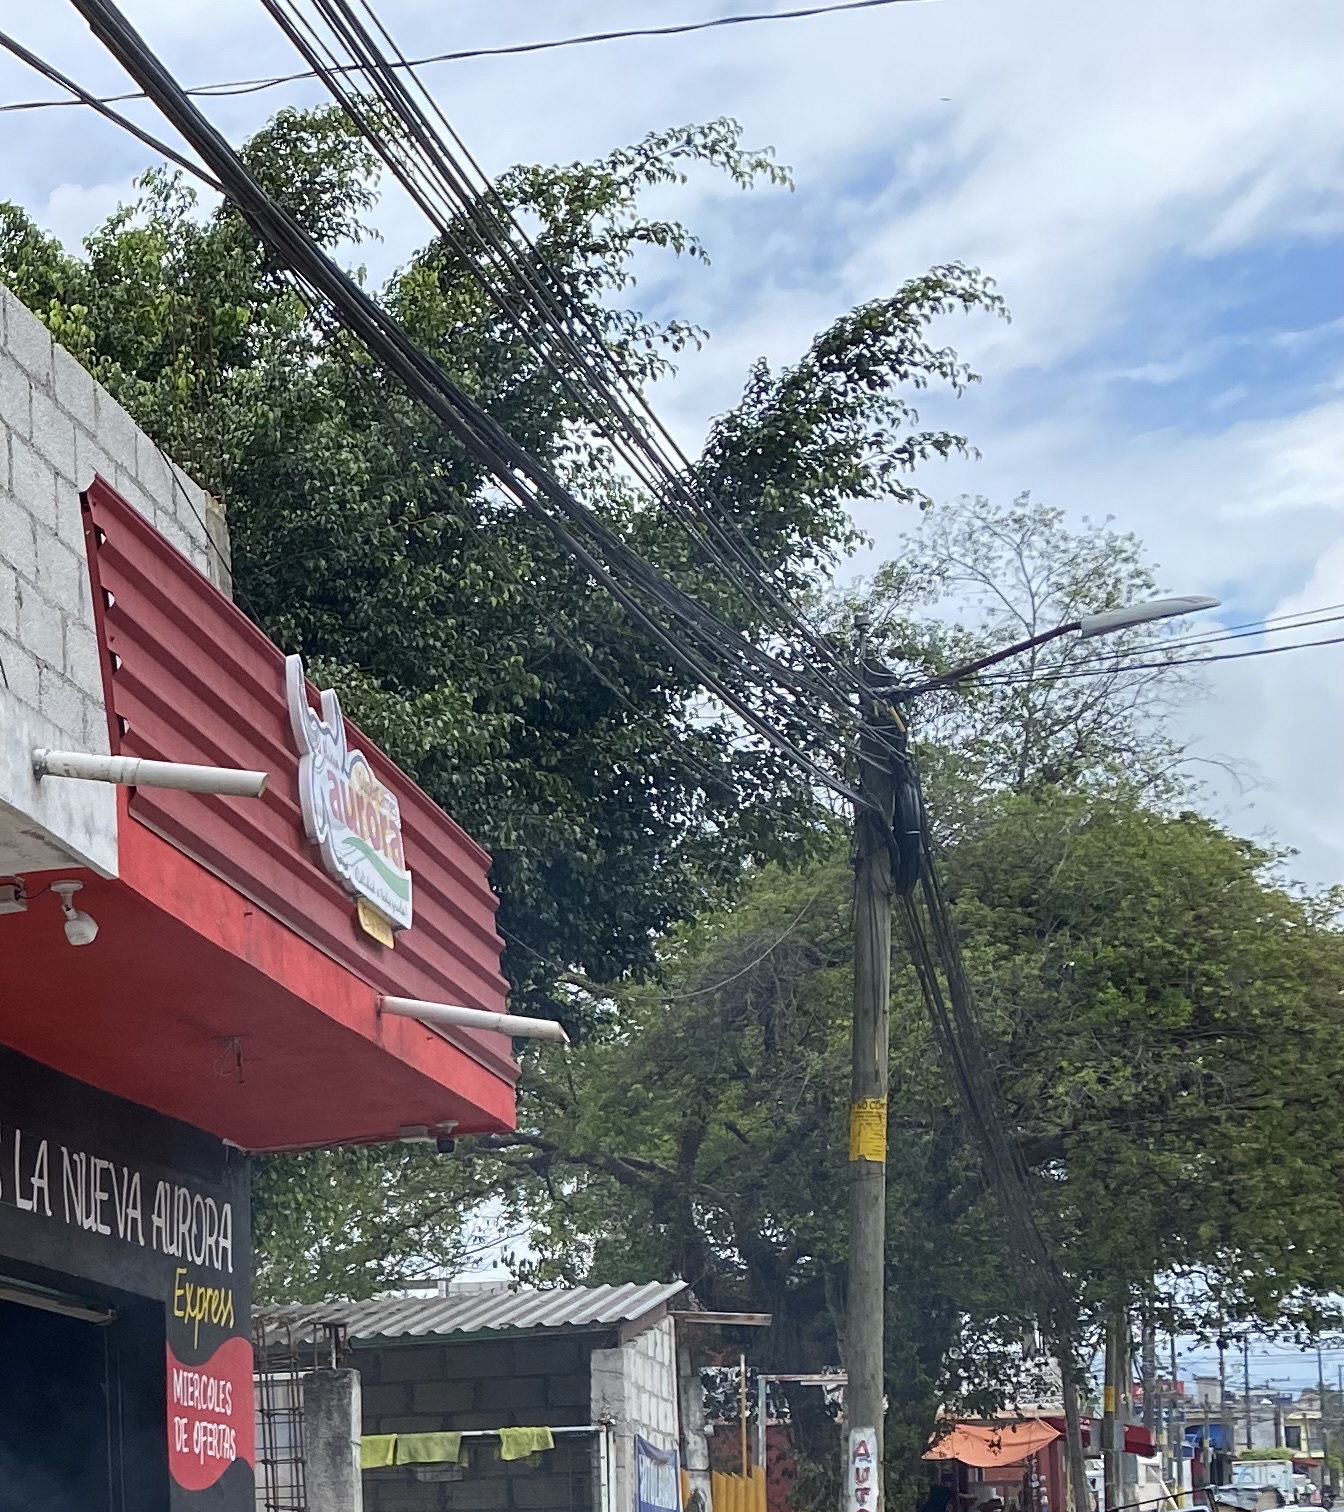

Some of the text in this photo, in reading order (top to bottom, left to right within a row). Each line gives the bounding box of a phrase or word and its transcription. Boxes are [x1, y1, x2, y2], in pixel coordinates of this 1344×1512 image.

[14, 1128, 52, 1217] LA
[60, 1146, 145, 1247] NUEVA
[151, 1179, 234, 1273] AURORA
[173, 1267, 235, 1350] Express
[173, 1367, 233, 1416] MIERCOLES
[174, 1416, 236, 1465] DE OFERTAS
